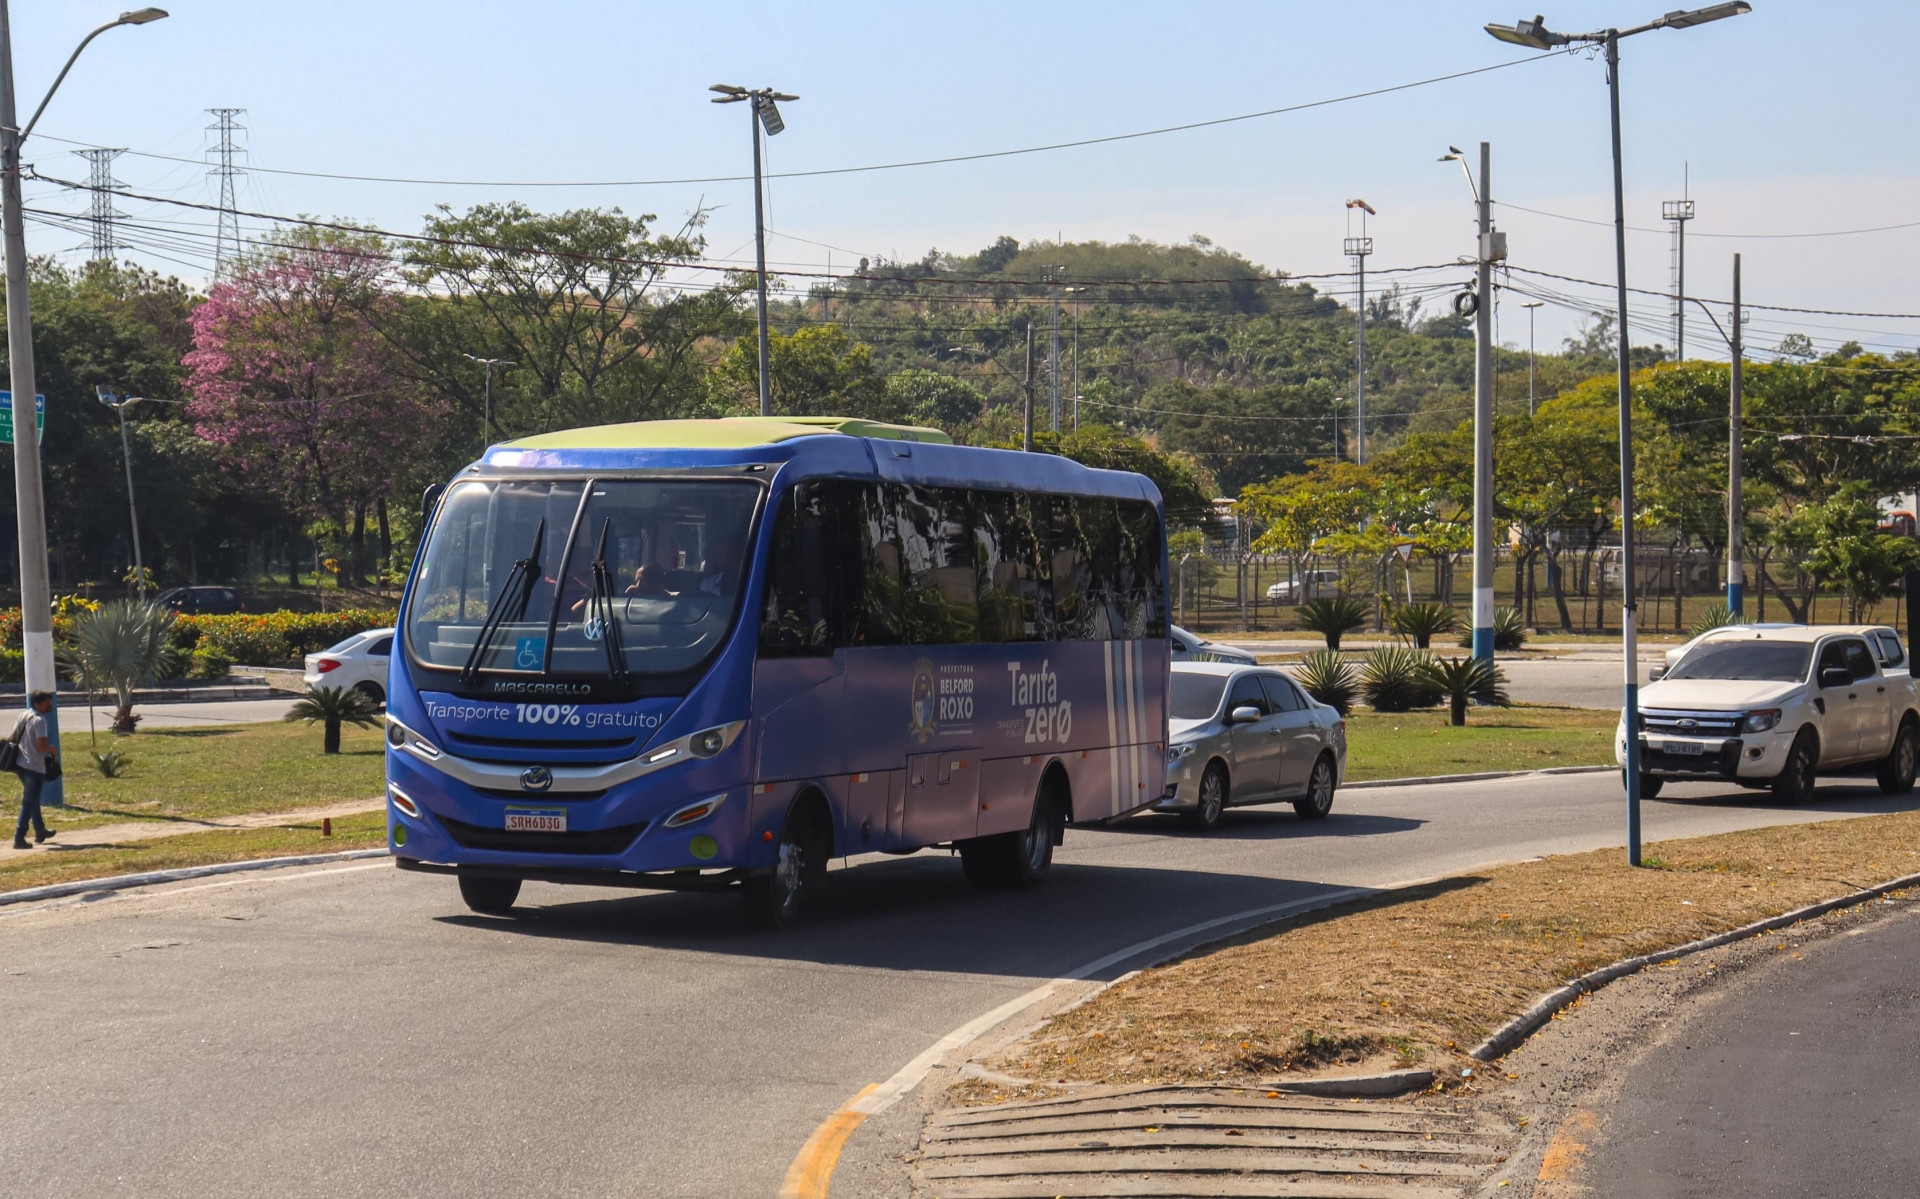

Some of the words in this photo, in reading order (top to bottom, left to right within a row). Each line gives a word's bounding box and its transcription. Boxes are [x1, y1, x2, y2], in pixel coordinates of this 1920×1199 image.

[940, 665, 974, 674] PREFEITURA
[494, 682, 591, 694] MASCARELLO
[940, 679, 974, 695] BELFORD
[1007, 659, 1057, 706] Tarifa
[426, 701, 510, 722] Transporte
[516, 703, 581, 726] 100%
[585, 711, 662, 728] gratuito!
[940, 697, 974, 720] ROXO
[510, 816, 560, 830] SRH6D30
